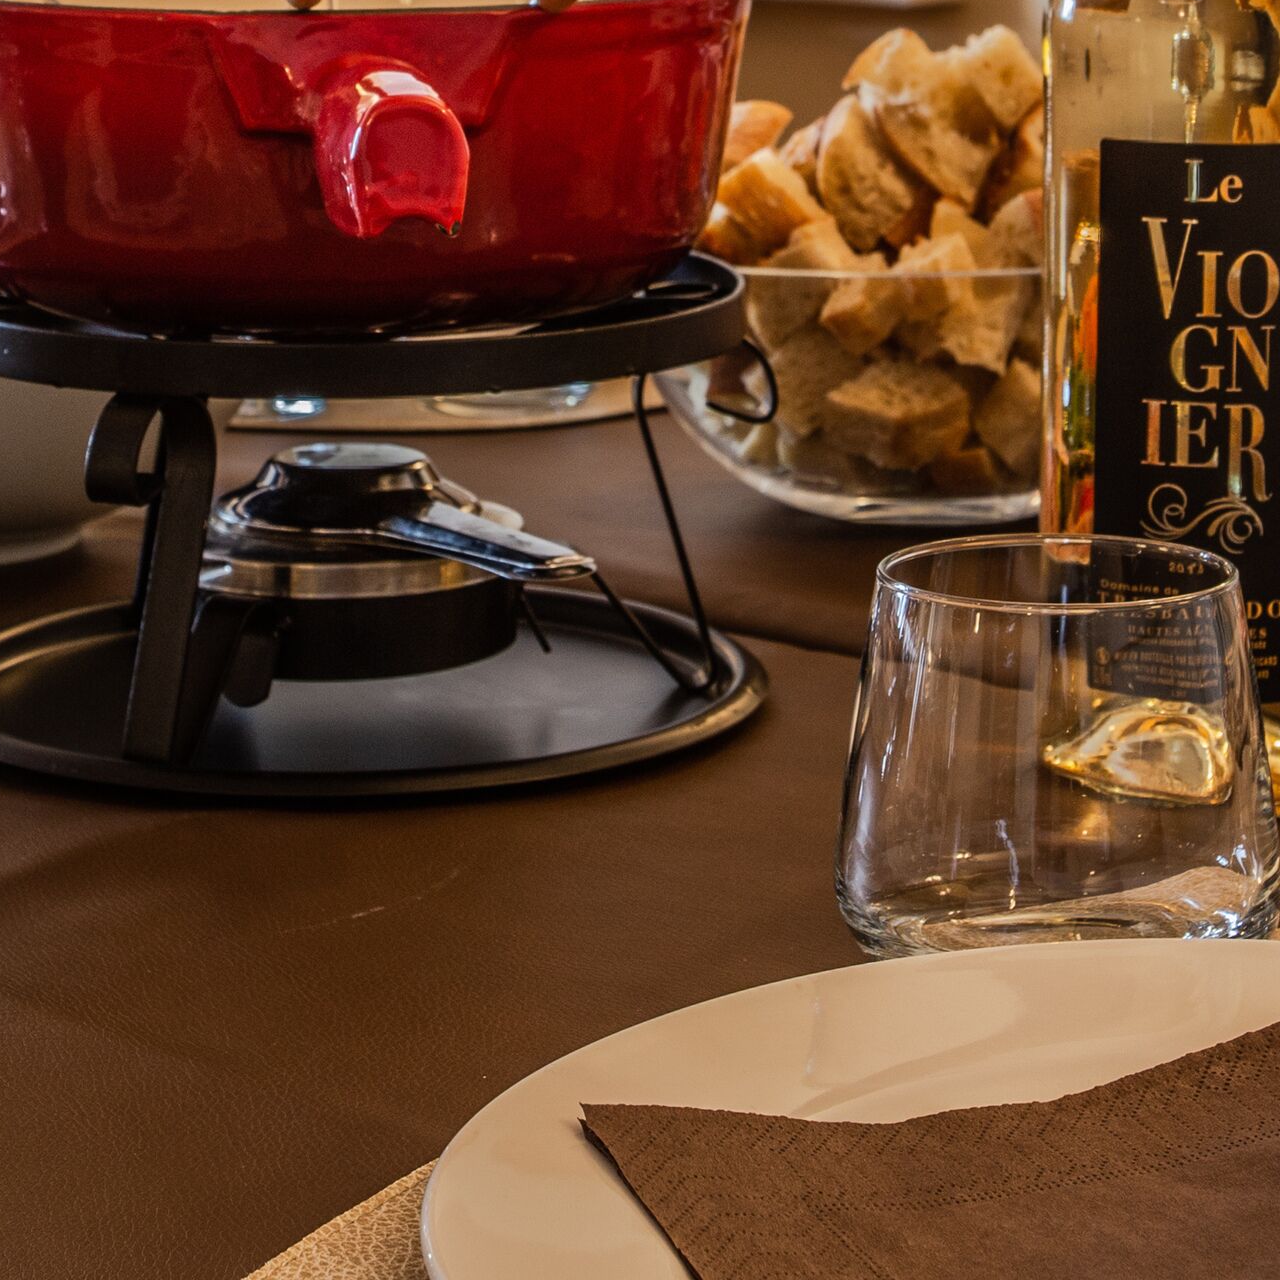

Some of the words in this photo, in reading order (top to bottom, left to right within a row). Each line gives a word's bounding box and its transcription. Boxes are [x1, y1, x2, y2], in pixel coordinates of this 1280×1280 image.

[1184, 159, 1243, 203] Le
[1141, 217, 1280, 319] VIO
[1170, 325, 1276, 393] GN
[1140, 399, 1272, 502] IER
[1100, 579, 1160, 594] Domaine
[1163, 585, 1180, 596] de
